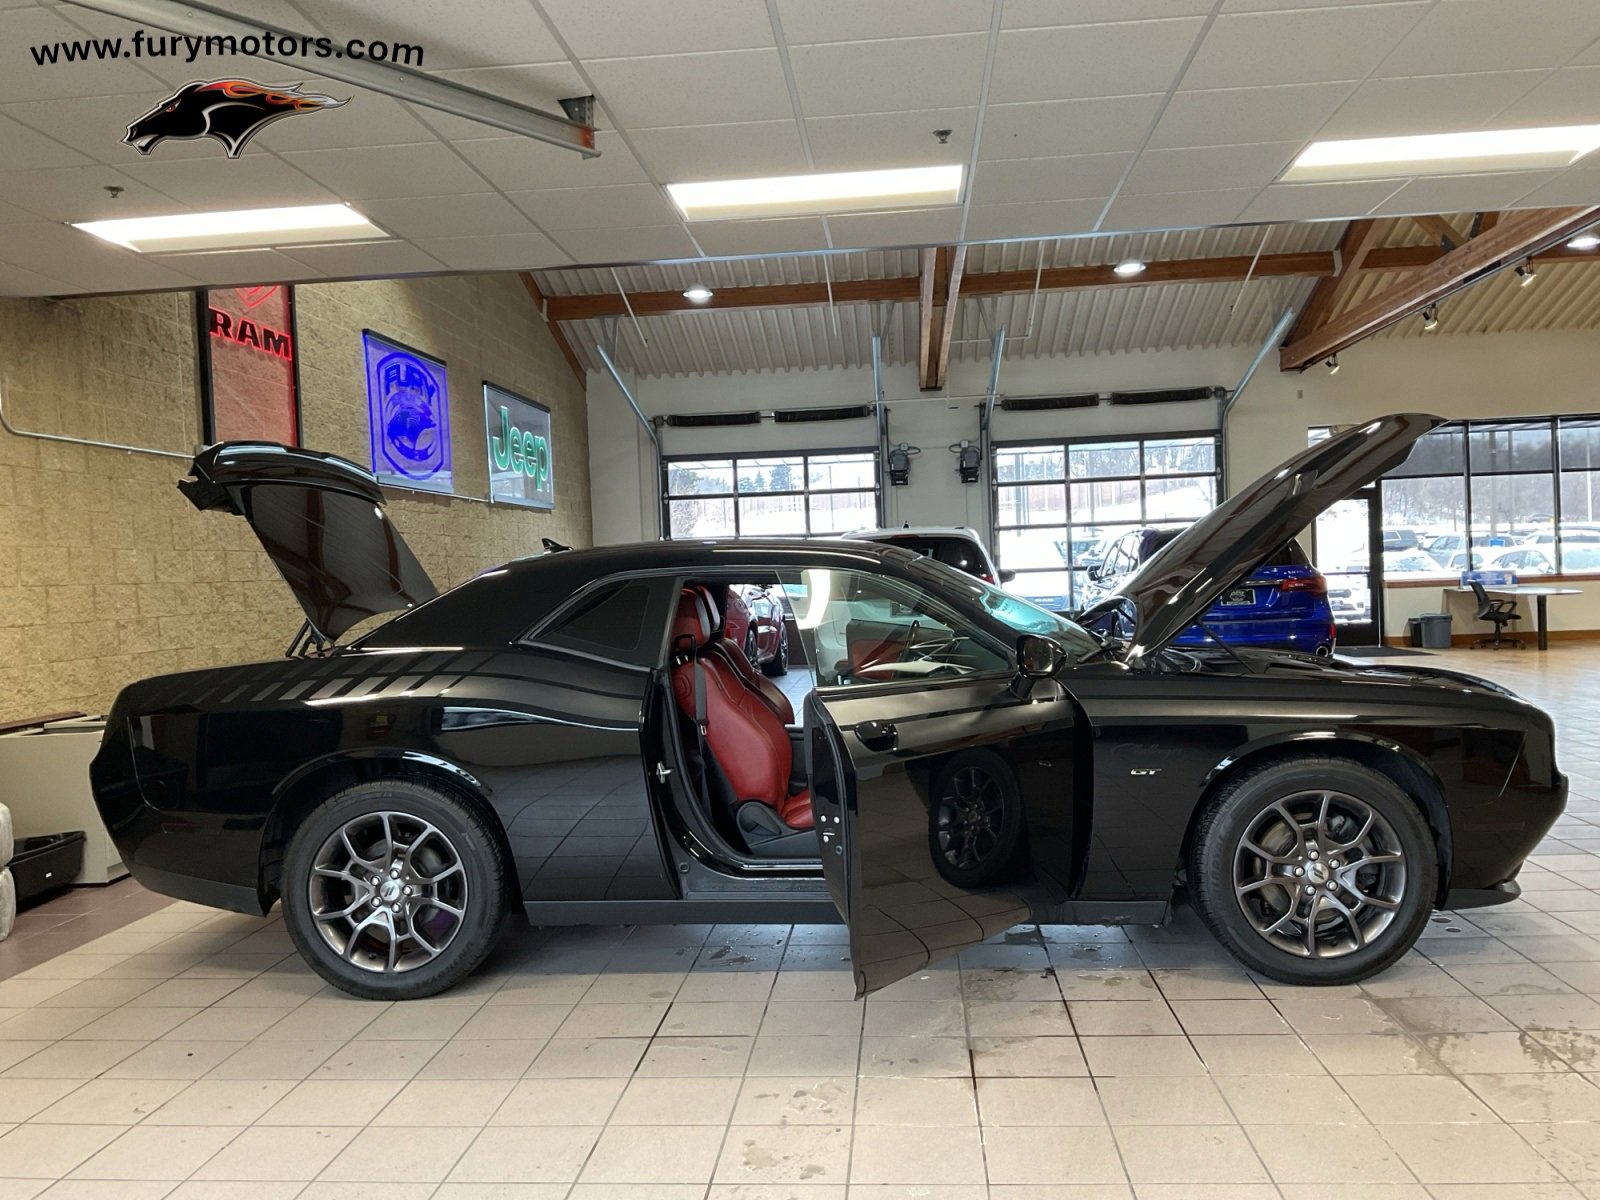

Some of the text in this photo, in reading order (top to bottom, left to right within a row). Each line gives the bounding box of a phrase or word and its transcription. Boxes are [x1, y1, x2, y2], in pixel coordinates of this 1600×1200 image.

[207, 305, 291, 360] RAM
[385, 363, 436, 406] FURY
[493, 405, 549, 492] Jeep
